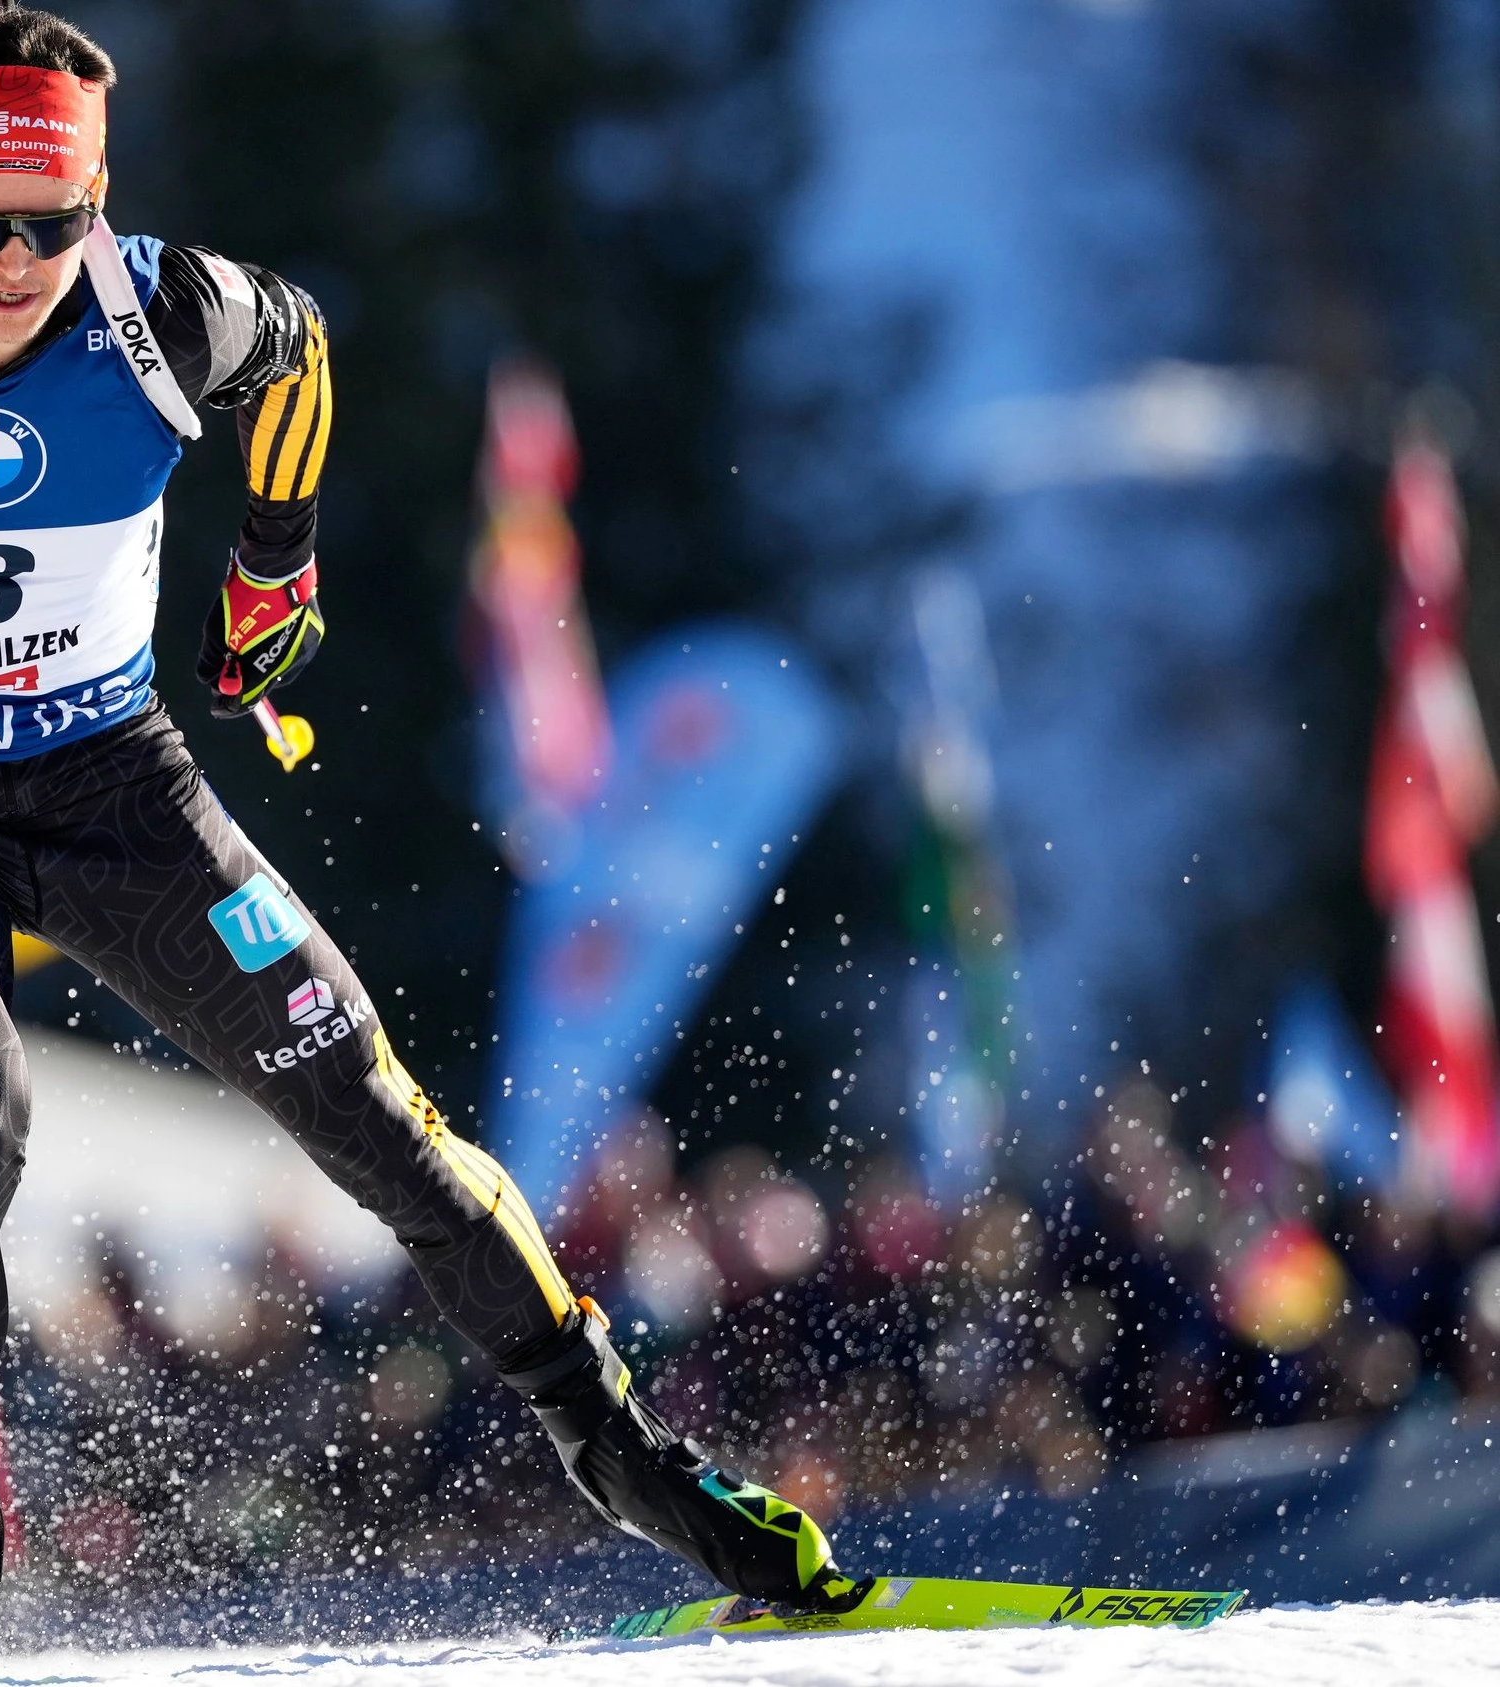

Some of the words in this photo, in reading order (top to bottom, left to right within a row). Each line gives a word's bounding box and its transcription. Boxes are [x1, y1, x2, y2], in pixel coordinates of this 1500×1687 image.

[87, 329, 119, 352] BM
[229, 601, 272, 651] LEKI
[254, 992, 373, 1074] tectake
[1085, 1595, 1224, 1622] FISCHER
